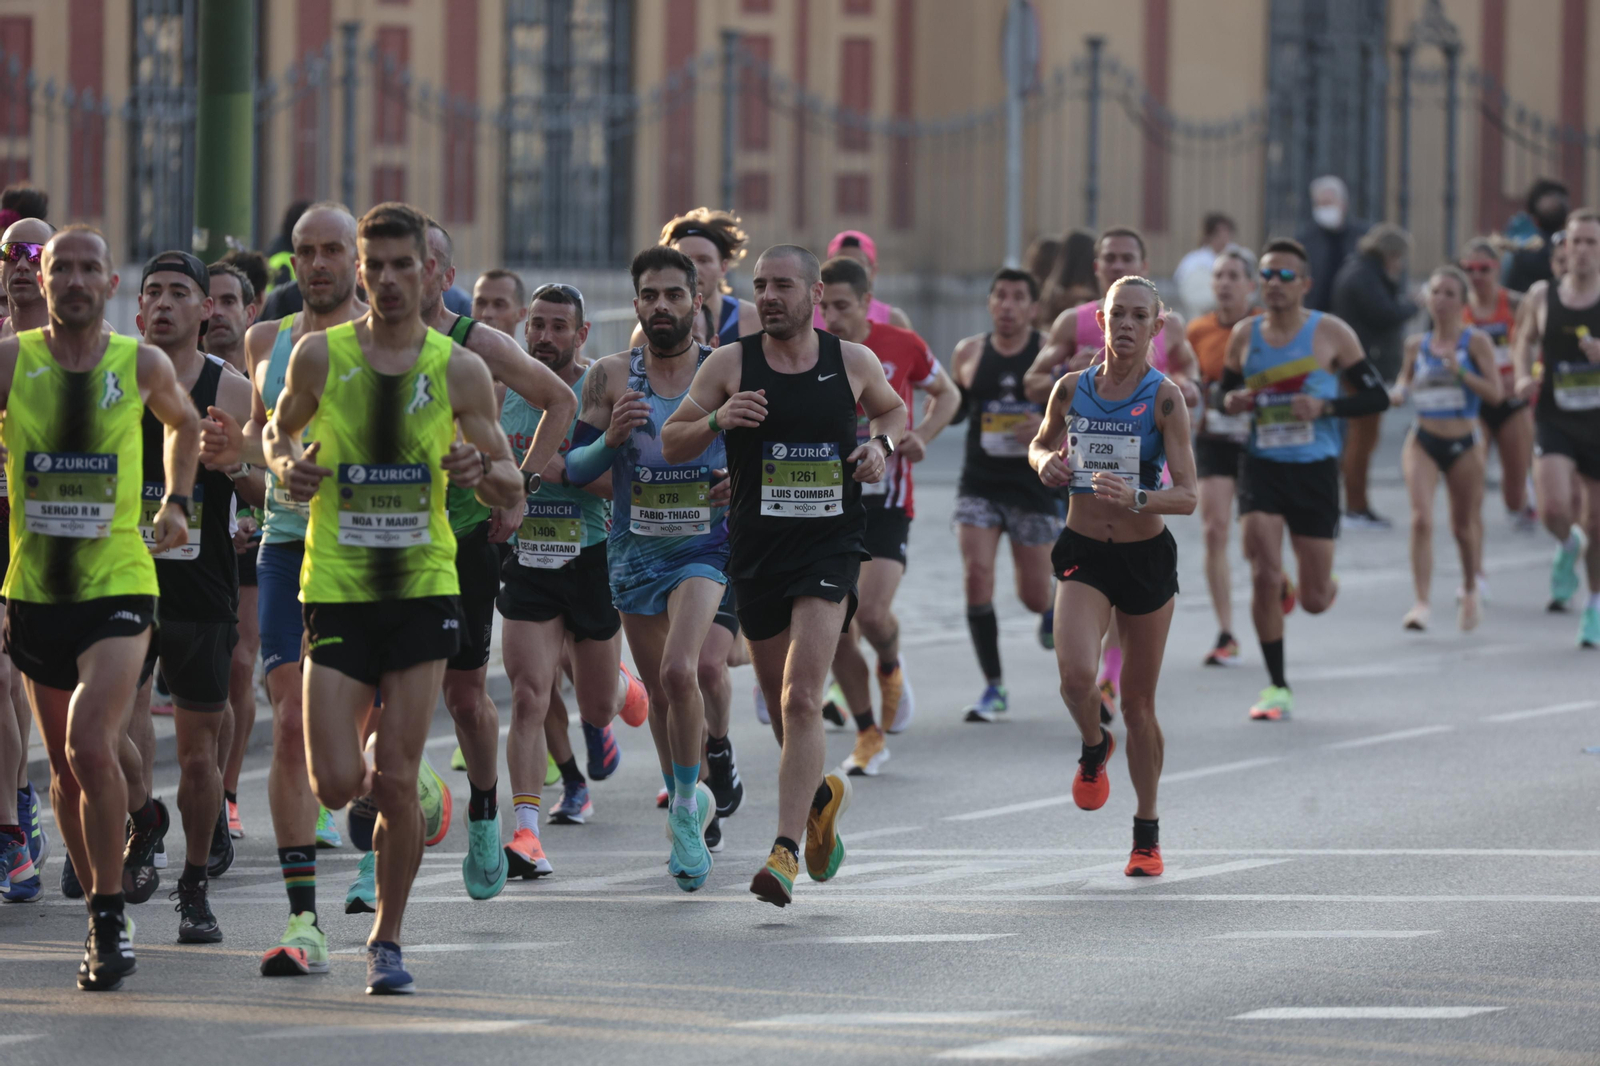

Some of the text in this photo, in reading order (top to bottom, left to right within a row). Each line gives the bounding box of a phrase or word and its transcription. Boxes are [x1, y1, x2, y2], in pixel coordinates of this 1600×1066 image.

[1090, 421, 1132, 432] ZURICH
[1089, 443, 1113, 454] F229
[55, 457, 109, 470] ZURICH
[1083, 461, 1119, 470] ADRIANA
[369, 468, 422, 480] ZURICH
[655, 469, 700, 481] ZURICH
[790, 471, 816, 482] 1261
[59, 484, 83, 497] 984
[771, 489, 834, 499] LUIS COIMBRA
[370, 495, 402, 508] 1576
[658, 493, 679, 504] 878
[41, 504, 100, 516] SERGIO R M
[531, 505, 572, 515] ZURICH
[639, 510, 700, 521] FABIO-THIAGO
[352, 515, 418, 527] NOA Y MARIO
[532, 527, 556, 538] 1406
[540, 544, 576, 554] CANTANO
